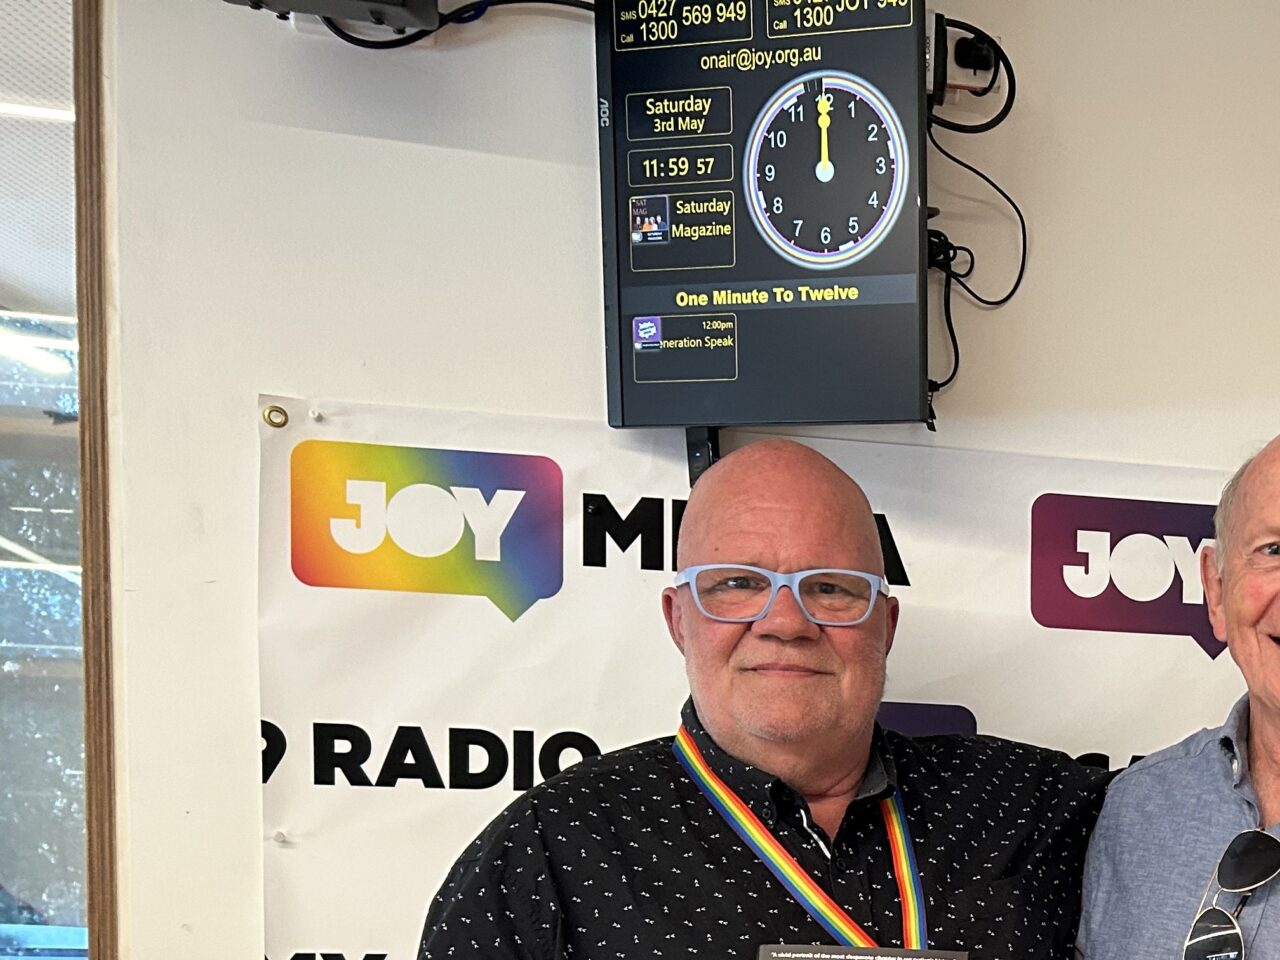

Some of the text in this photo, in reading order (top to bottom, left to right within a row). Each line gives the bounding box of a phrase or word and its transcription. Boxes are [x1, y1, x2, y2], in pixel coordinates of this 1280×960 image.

[620, 0, 676, 21] SMS 0427
[682, 1, 747, 26] 569 949
[773, 6, 834, 30] Call 1300
[620, 20, 678, 43] Call 1300
[700, 46, 822, 71] onair@joy.org.au
[646, 95, 712, 116] Saturday
[788, 104, 804, 122] 11
[848, 100, 855, 118] 1
[653, 116, 705, 133] 3rd May
[867, 124, 878, 142] 2
[768, 130, 787, 148] 10
[696, 157, 715, 175] 57
[765, 164, 775, 182] 9
[875, 157, 886, 175] 3
[676, 198, 731, 216] Saturday
[773, 197, 783, 214] 8
[868, 191, 879, 208] 4
[671, 221, 732, 241] Magazine
[793, 220, 803, 237] 7
[848, 217, 859, 234] 5
[820, 227, 831, 244] 6
[675, 284, 860, 307] One Minute To Twelve
[702, 320, 734, 331] 12:00pm
[704, 335, 734, 349] Speak
[330, 479, 527, 562] JOY
[1063, 530, 1217, 605] JOY
[313, 722, 600, 791] RADIO
